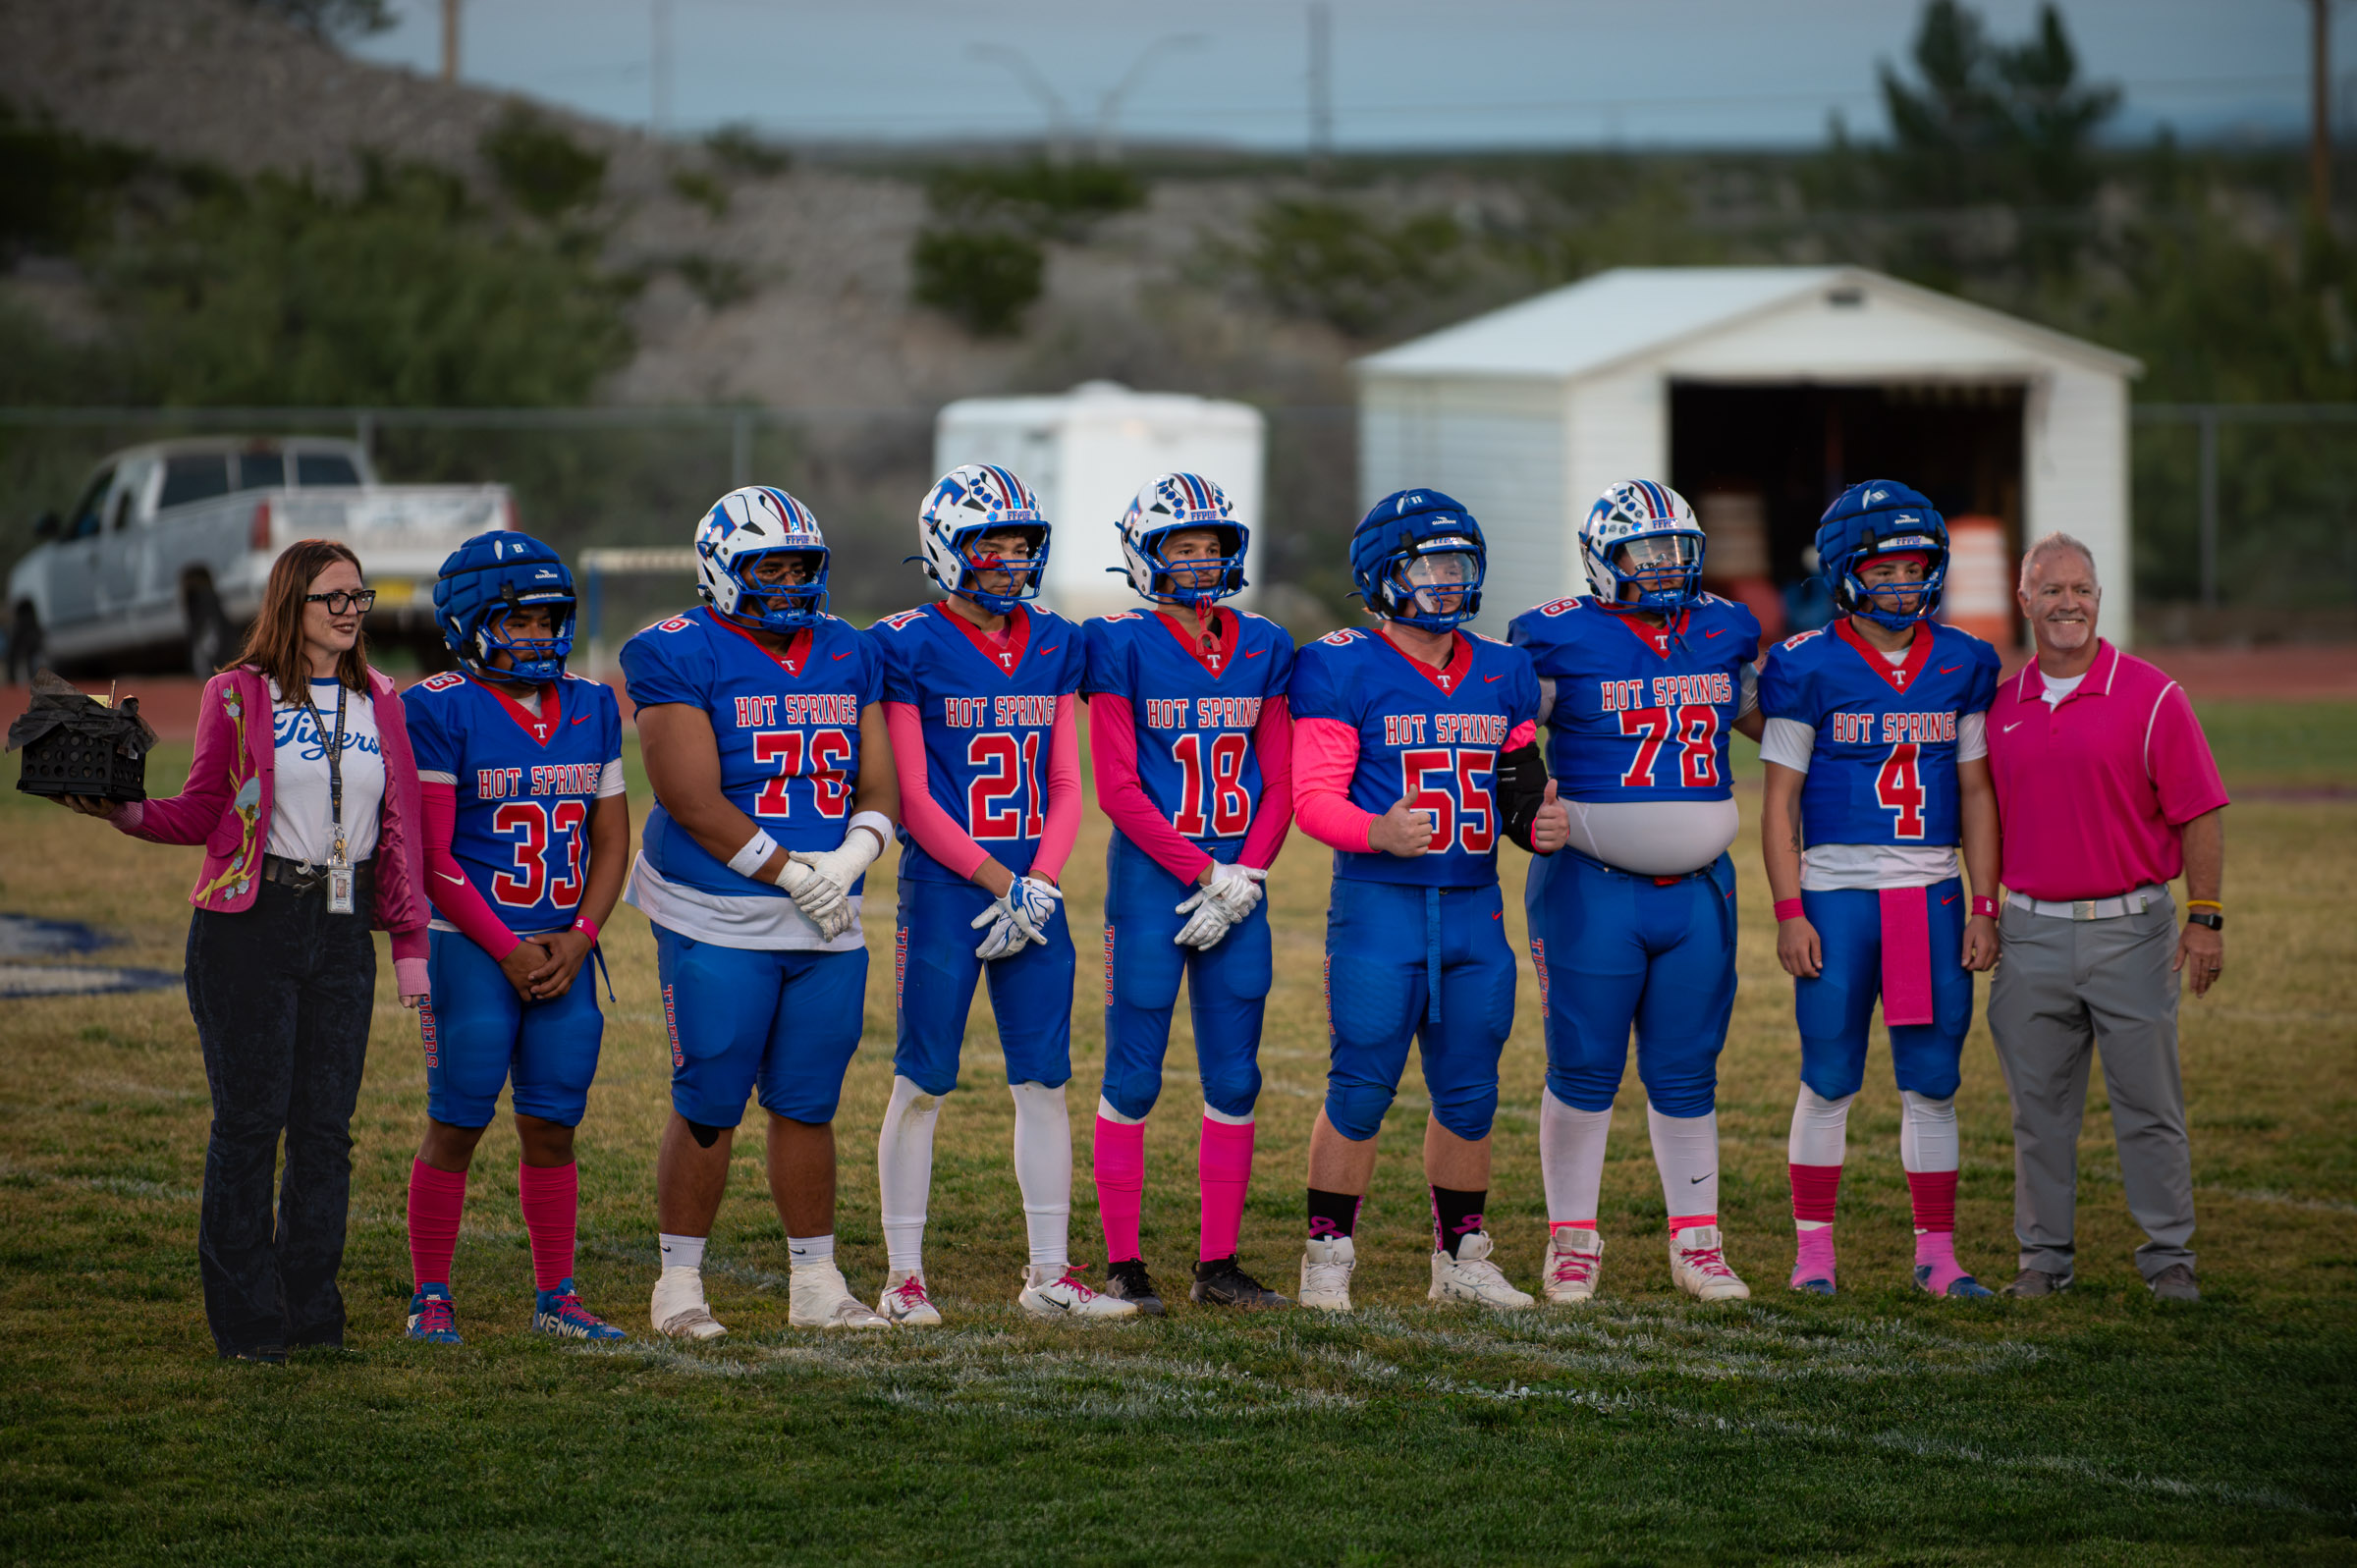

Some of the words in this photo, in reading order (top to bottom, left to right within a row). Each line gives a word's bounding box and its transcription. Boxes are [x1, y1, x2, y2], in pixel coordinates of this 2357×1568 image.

[1655, 635, 1668, 650] T
[781, 660, 795, 672] T
[999, 653, 1013, 668] T
[1207, 654, 1221, 669] T
[1891, 670, 1906, 684] T
[1437, 676, 1451, 688] T
[1601, 678, 1644, 711] HOT
[1652, 674, 1732, 706] SPRINGS
[735, 695, 777, 729] HOT
[785, 694, 857, 726] SPRINGS
[945, 696, 988, 729] HOT
[994, 695, 1058, 728] SPRING
[1146, 698, 1189, 729] HOT
[1197, 695, 1264, 729] SPRING
[1834, 712, 1874, 743] HOT
[274, 707, 380, 761] Tigers
[533, 724, 547, 738] T
[1384, 715, 1427, 746] HOT
[1435, 714, 1508, 745] SPRINGS
[1617, 704, 1721, 787] 78
[477, 768, 522, 799] HOT
[530, 763, 602, 795] SPRINGS
[752, 729, 852, 819] 76
[967, 731, 1044, 840] 21
[1172, 732, 1251, 838] 18
[1874, 742, 1926, 839] 4
[1400, 748, 1496, 854] 55
[491, 799, 587, 909] 33
